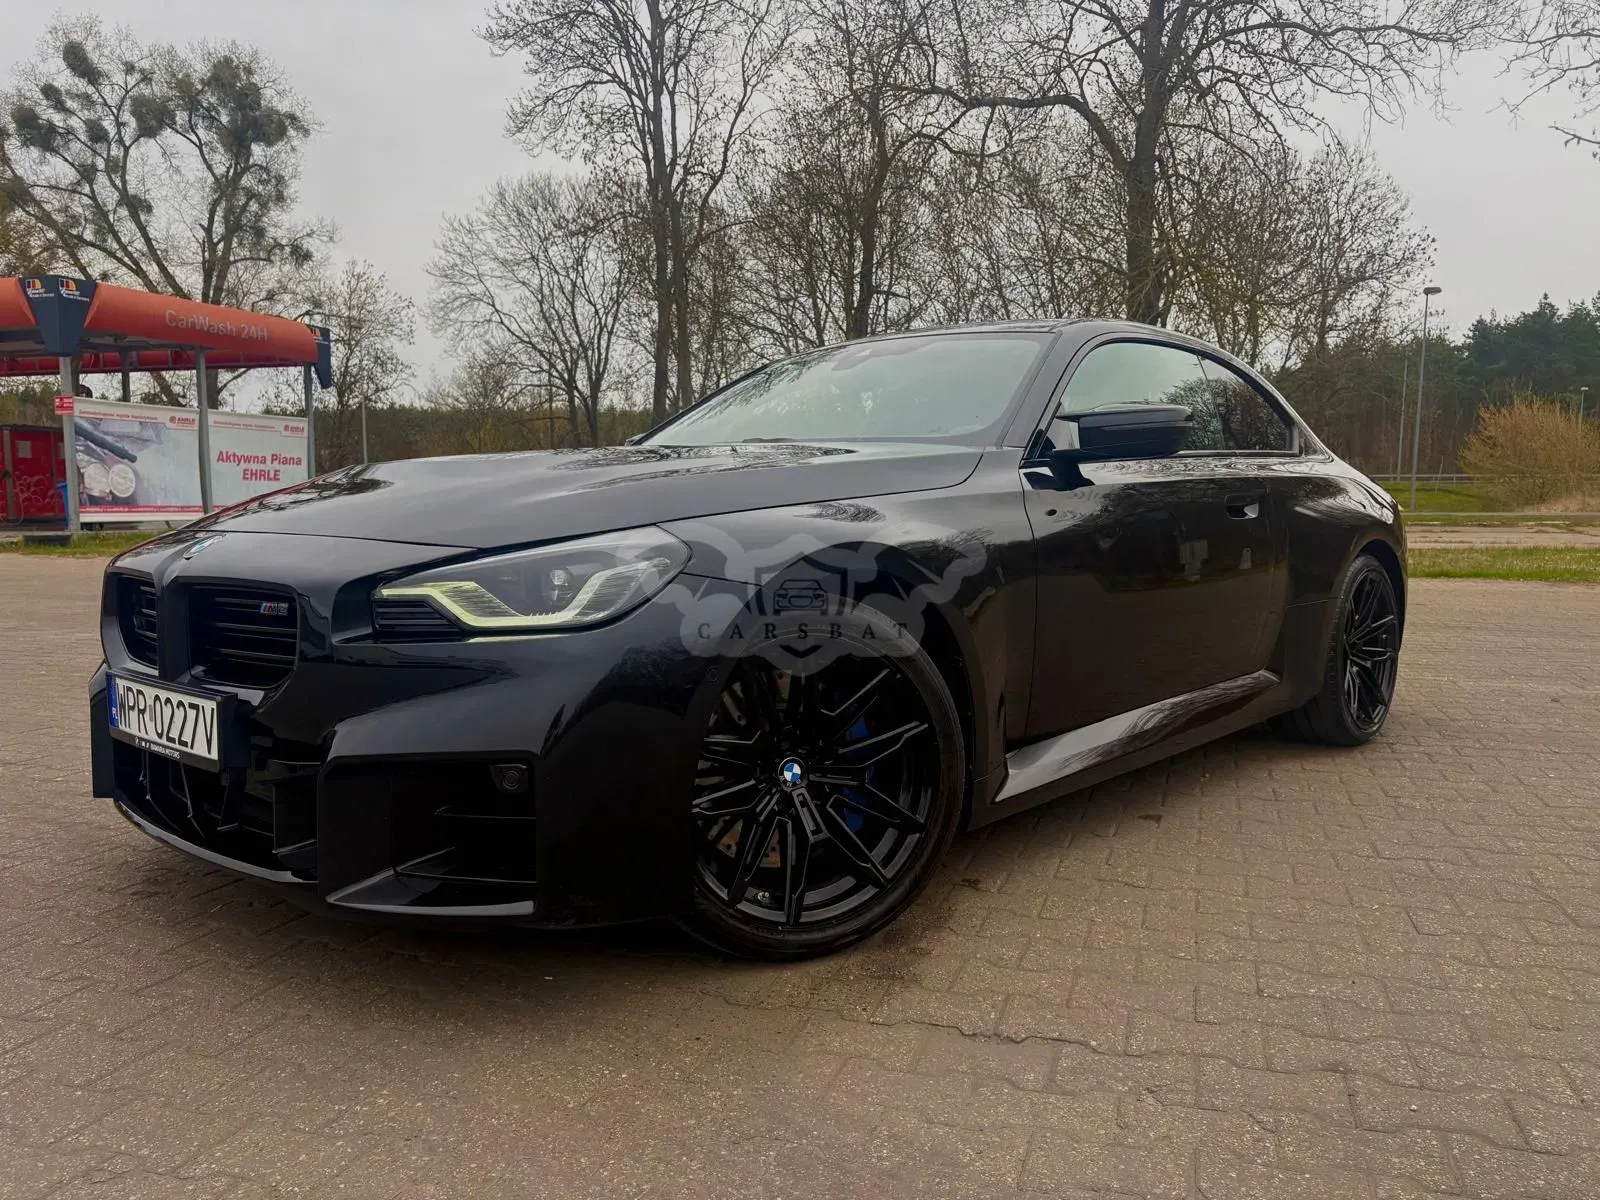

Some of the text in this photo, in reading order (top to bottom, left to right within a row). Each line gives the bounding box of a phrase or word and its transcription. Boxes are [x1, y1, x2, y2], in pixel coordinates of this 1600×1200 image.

[165, 309, 268, 341] CarWash 24H
[216, 450, 302, 466] Aktywna Piana
[242, 468, 281, 481] EHRLE
[116, 682, 215, 756] WPR 0227V
